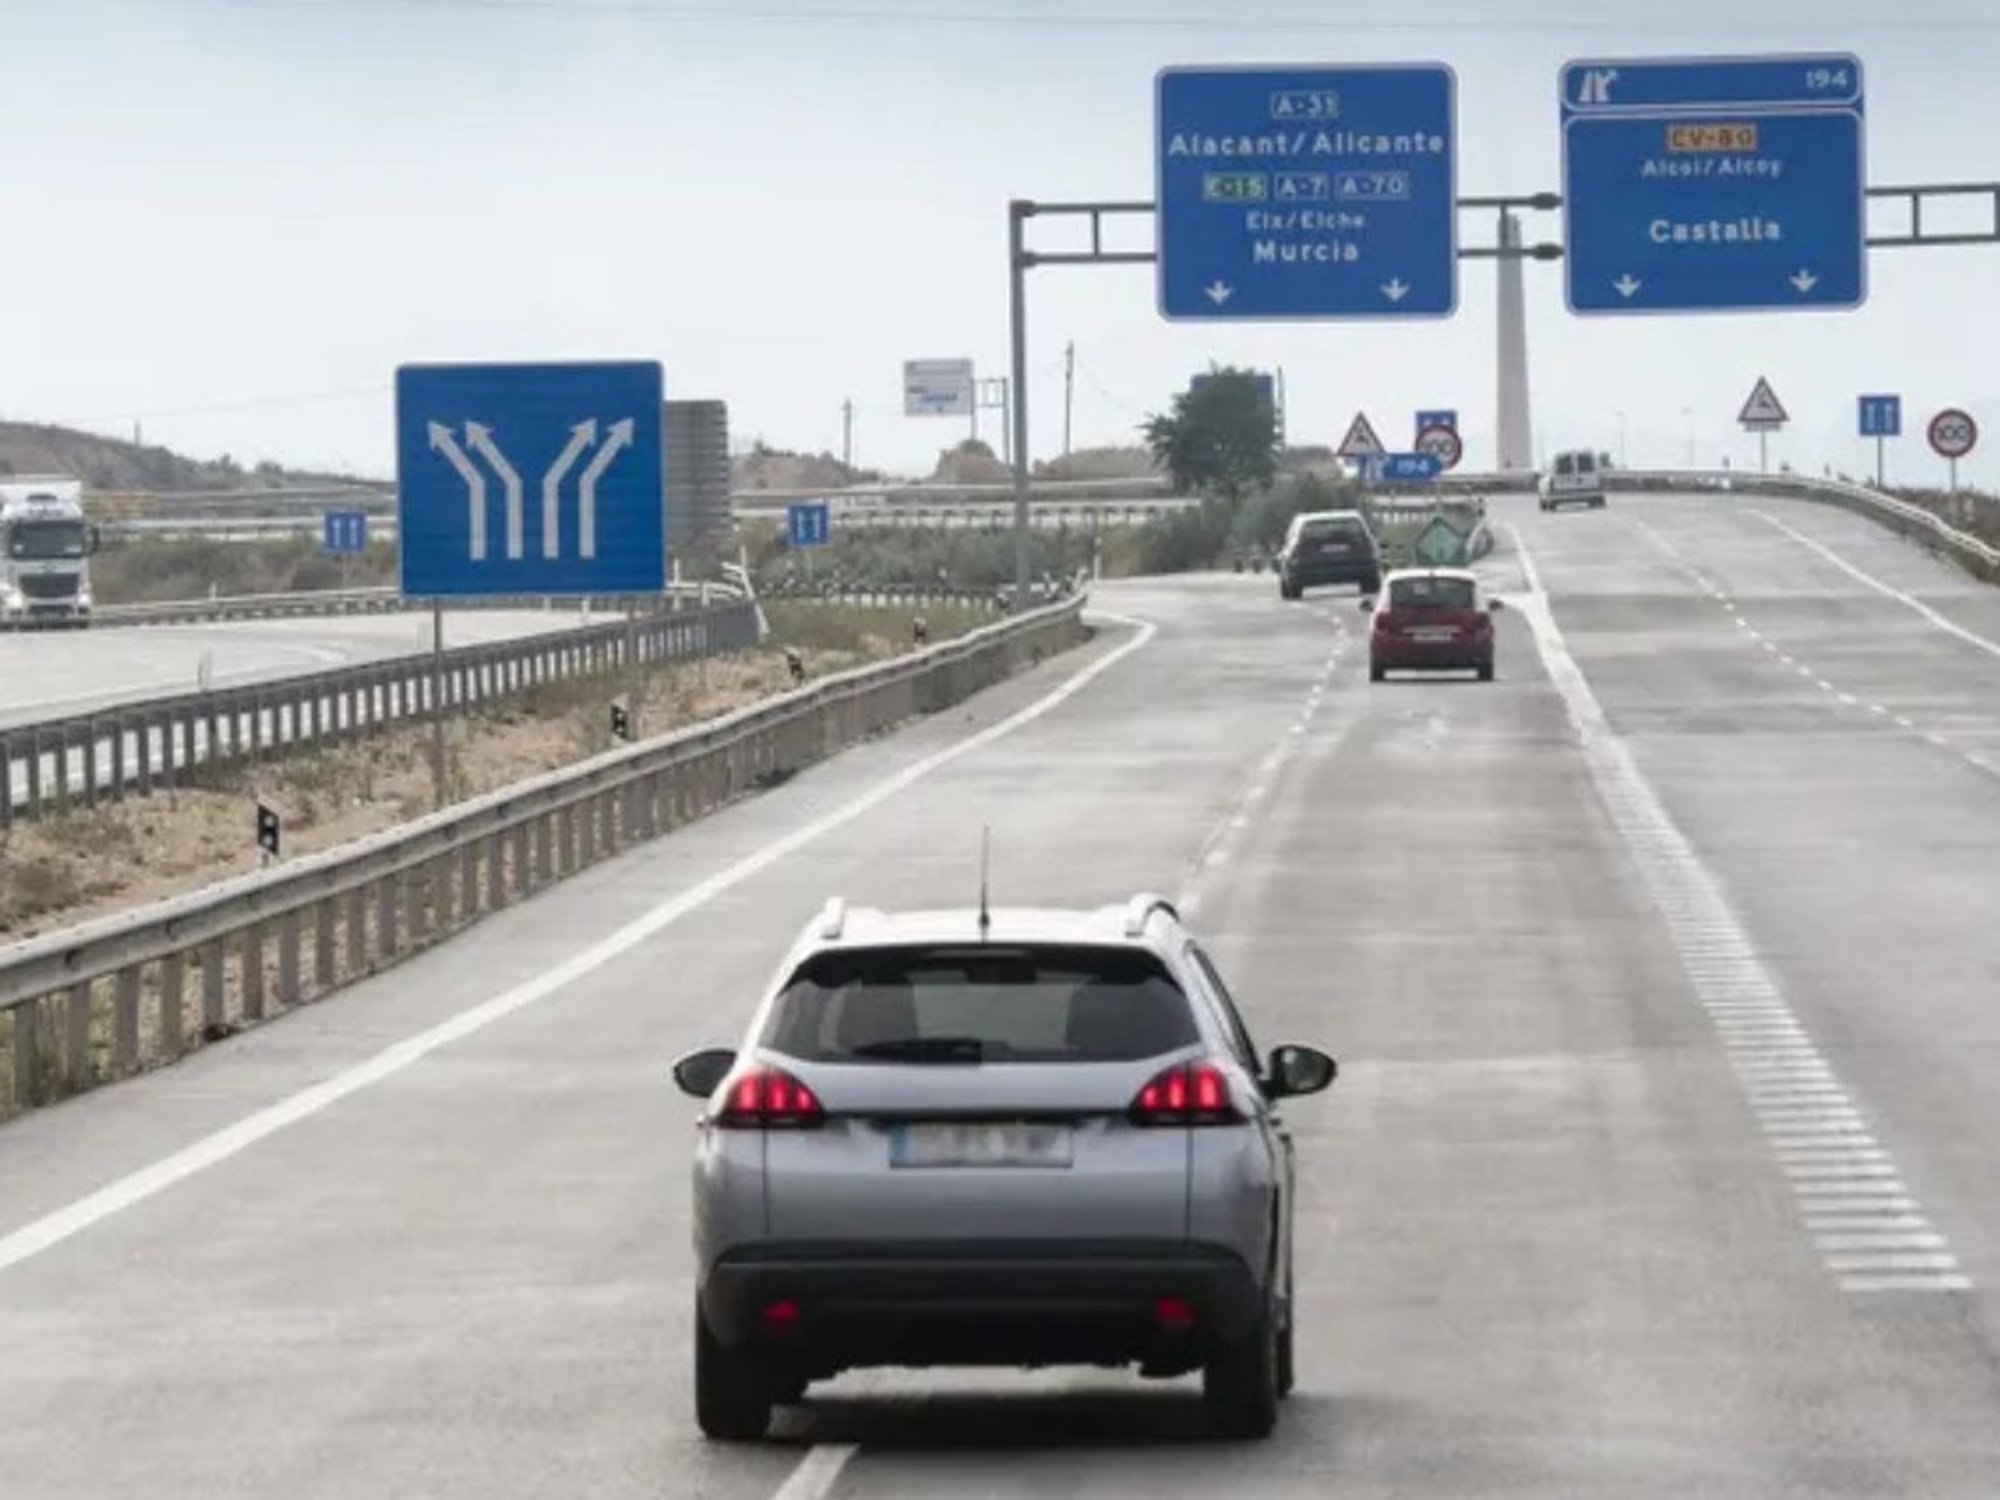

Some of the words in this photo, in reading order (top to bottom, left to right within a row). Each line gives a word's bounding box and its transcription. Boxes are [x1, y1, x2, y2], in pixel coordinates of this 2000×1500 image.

[1805, 68, 1849, 90] 194
[1276, 95, 1337, 115] A-31
[1671, 127, 1753, 148] CV-80
[1279, 176, 1324, 197] A-7
[1341, 174, 1404, 196] A-70
[1649, 218, 1781, 243] Castalla
[1253, 239, 1360, 263] Murcia
